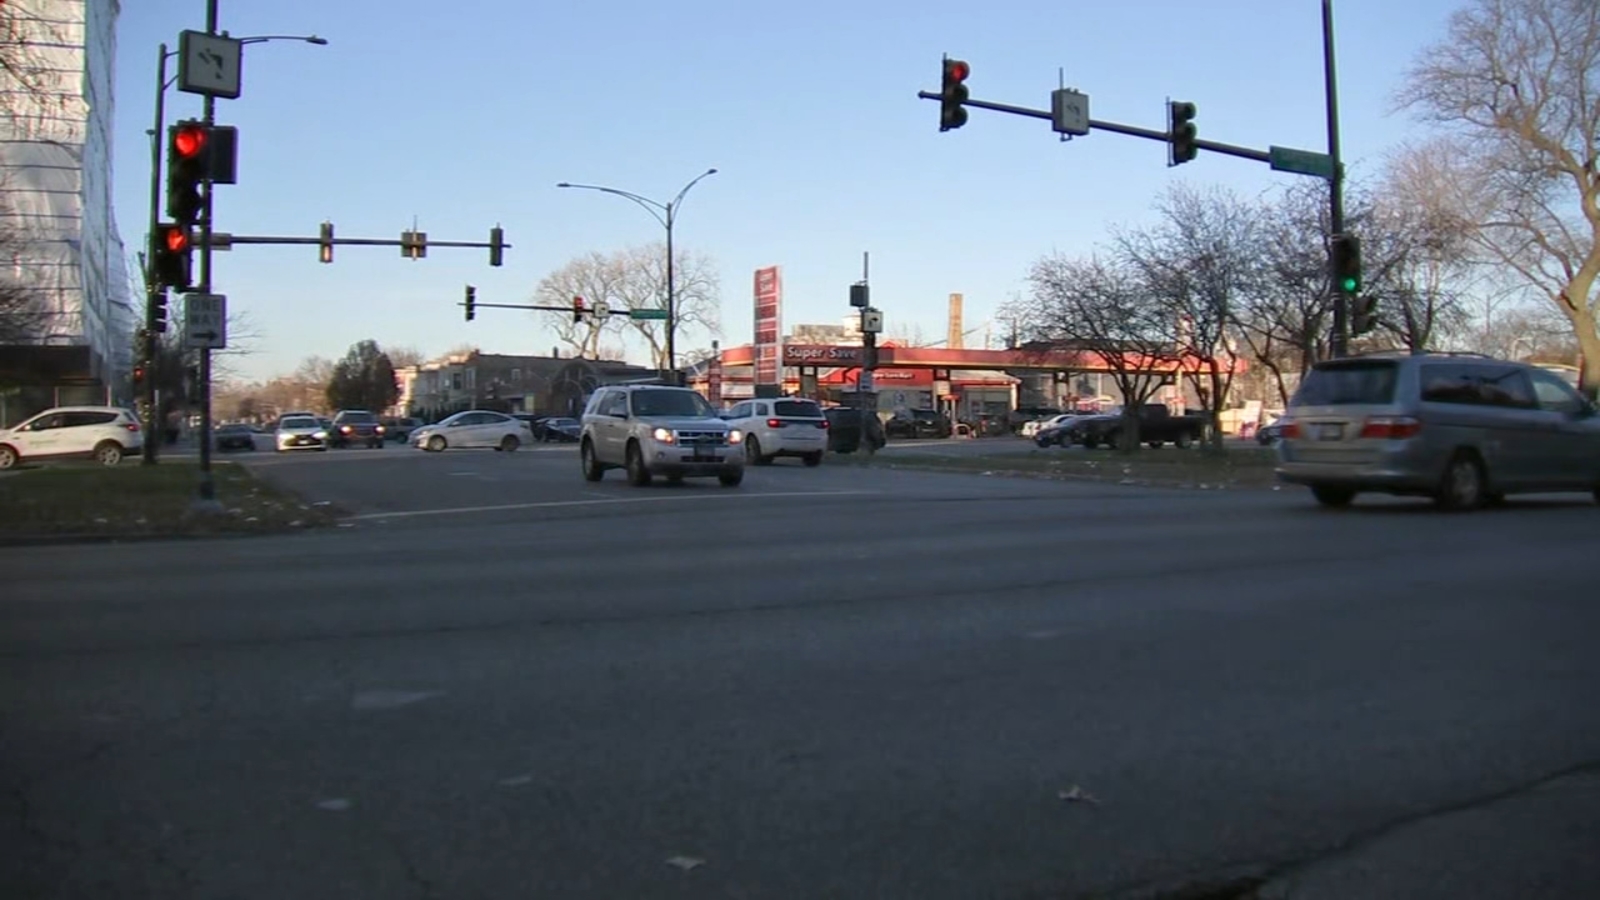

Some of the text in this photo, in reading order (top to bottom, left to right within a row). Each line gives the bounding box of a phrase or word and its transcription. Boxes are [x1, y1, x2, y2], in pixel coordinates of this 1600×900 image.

[190, 299, 220, 312] ONE
[190, 313, 220, 326] WAY
[787, 346, 823, 360] Super
[829, 347, 857, 358] Save
